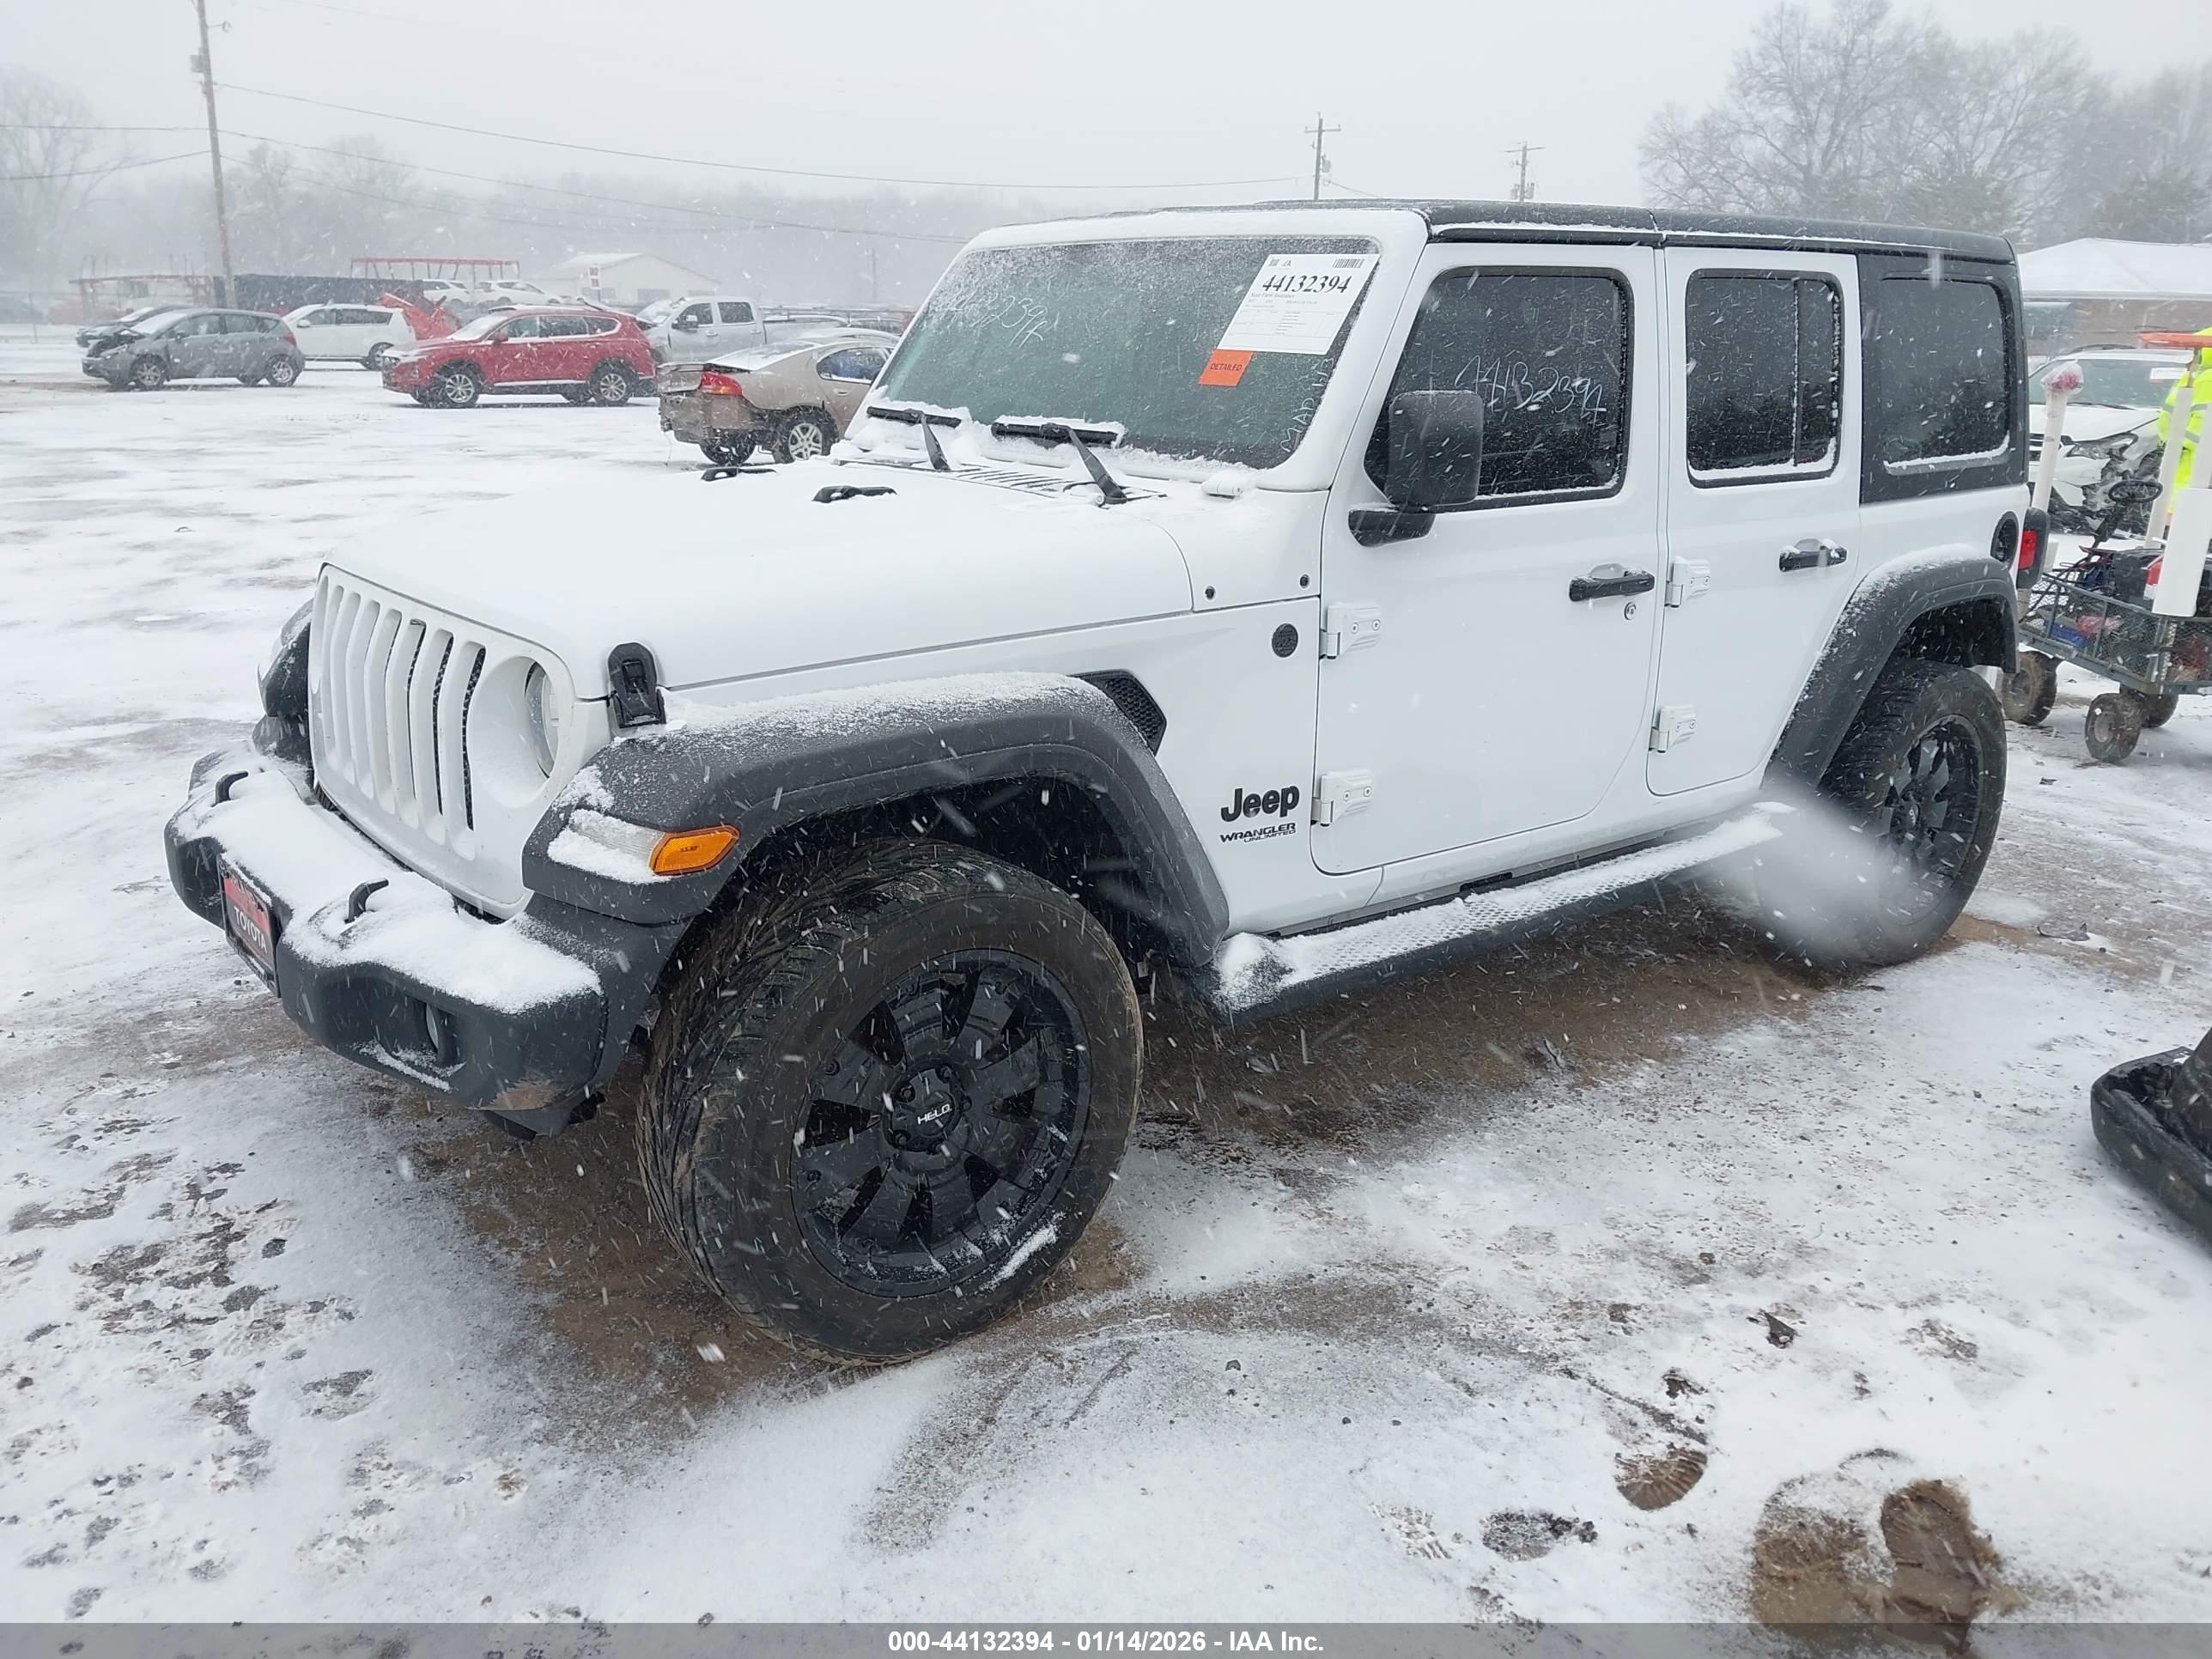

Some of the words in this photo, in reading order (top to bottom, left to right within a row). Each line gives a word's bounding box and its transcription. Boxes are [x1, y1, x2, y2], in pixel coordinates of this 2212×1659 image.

[1262, 274, 1354, 294] 44132394
[1209, 362, 1243, 372] DETAILED
[1220, 785, 1301, 823] Jeep
[1219, 823, 1297, 843] WRANGLER
[1243, 830, 1297, 843] UNLIMITED
[234, 905, 268, 954] TOYOTA
[917, 1103, 952, 1125] HELO
